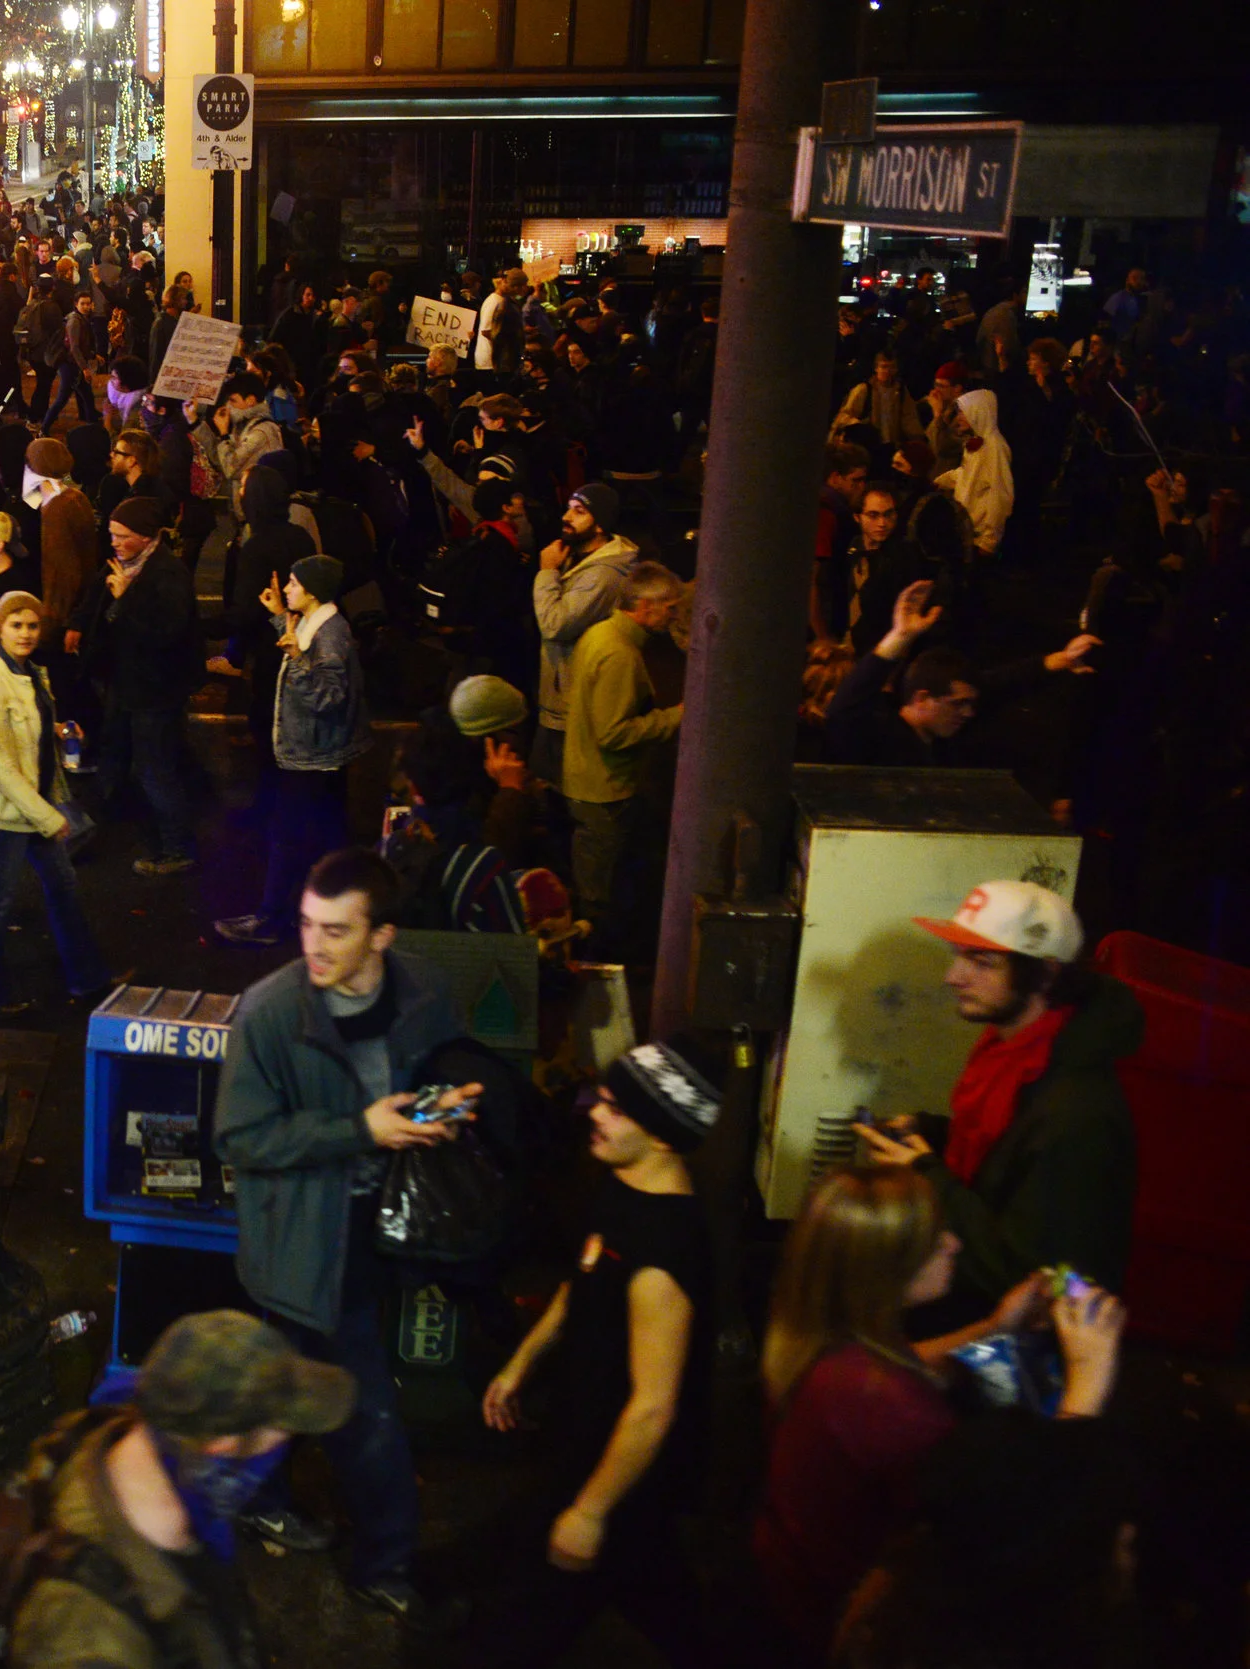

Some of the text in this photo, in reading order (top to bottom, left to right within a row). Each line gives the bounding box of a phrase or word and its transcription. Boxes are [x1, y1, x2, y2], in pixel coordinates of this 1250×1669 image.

[202, 92, 246, 101] SMART
[206, 104, 240, 113] PARK
[197, 134, 247, 142] 4th & Alder
[822, 145, 1001, 214] SW MORRISON ST
[422, 306, 461, 330] END
[414, 326, 469, 351] RACISM
[124, 1021, 180, 1055] OME
